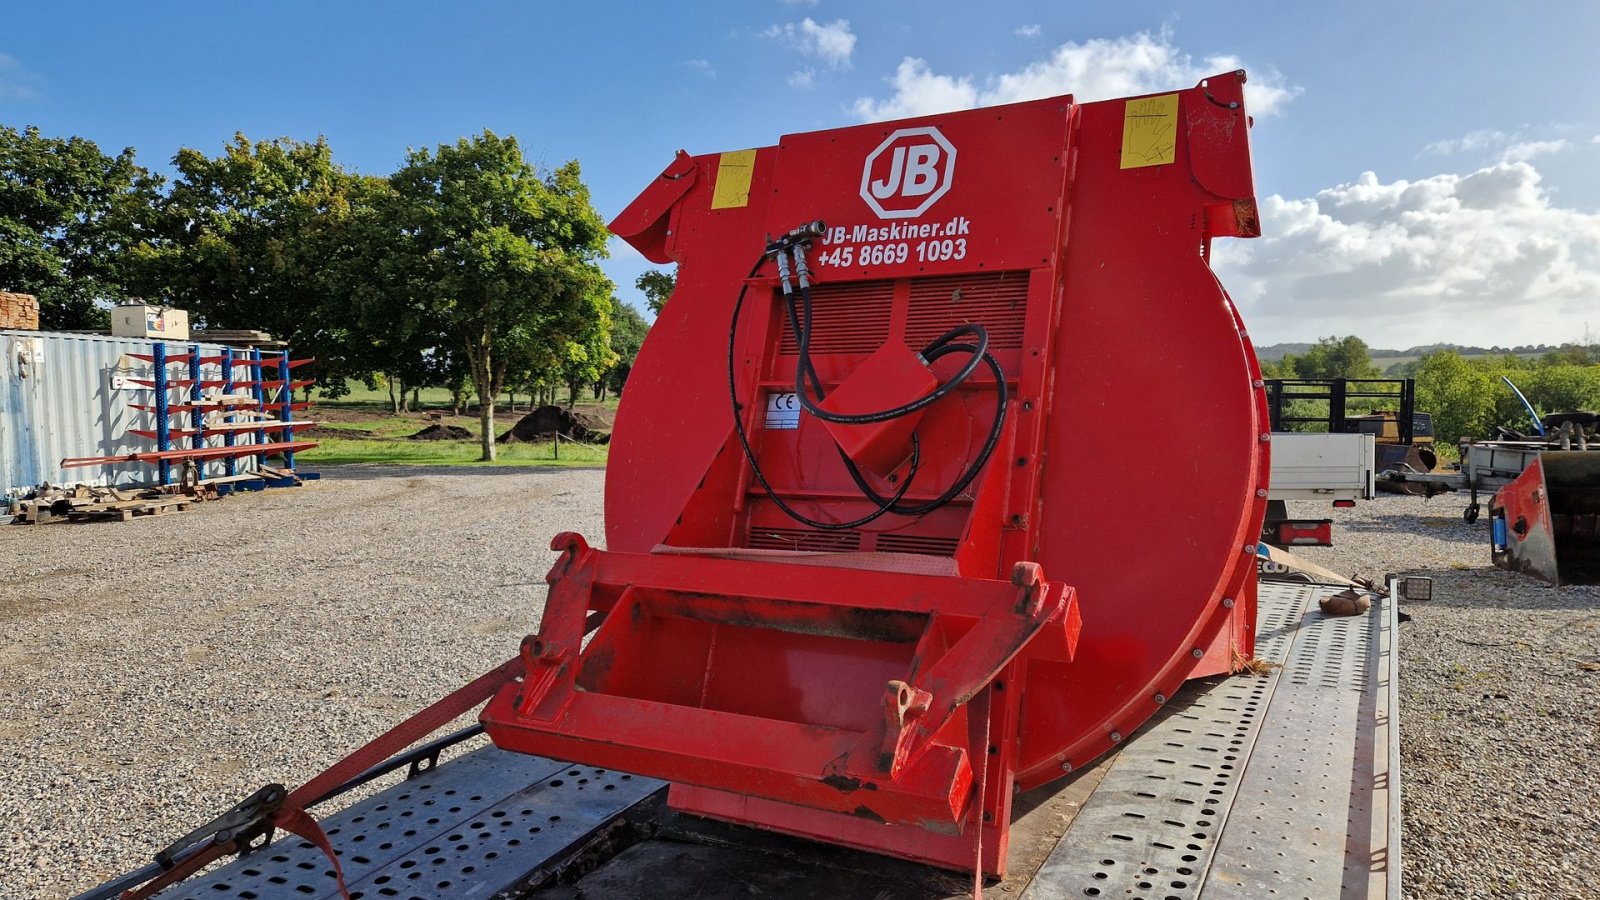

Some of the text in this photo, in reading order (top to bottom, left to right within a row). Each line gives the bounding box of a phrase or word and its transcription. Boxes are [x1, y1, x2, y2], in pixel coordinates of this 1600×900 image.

[872, 144, 940, 199] JB
[822, 216, 970, 245] JB-Maskiner.dk
[818, 238, 967, 267] +45 8669 1093
[775, 394, 795, 410] CE
